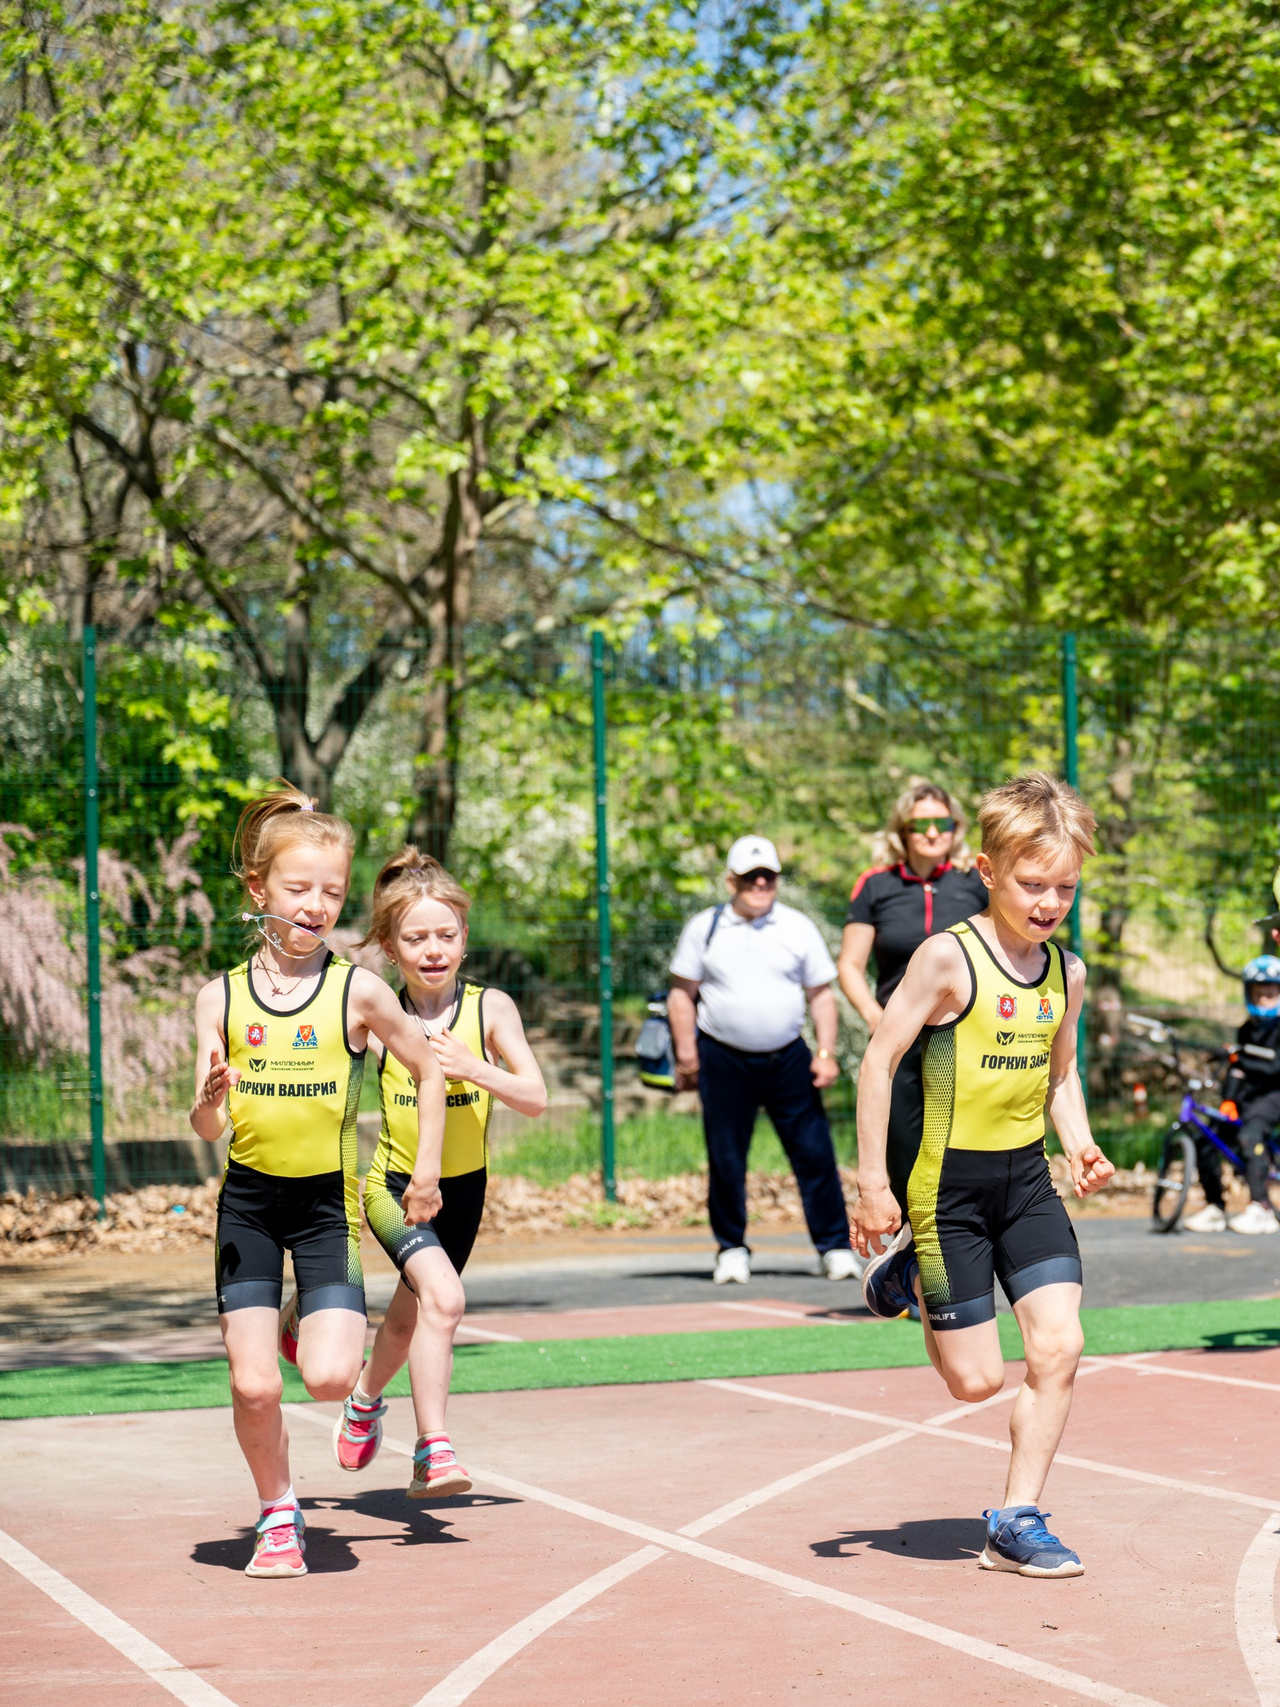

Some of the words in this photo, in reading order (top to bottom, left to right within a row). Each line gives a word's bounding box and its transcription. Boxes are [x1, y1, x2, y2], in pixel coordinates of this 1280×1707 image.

[980, 1054, 1027, 1070] ГОРКУН
[235, 1080, 275, 1097] ГОРКУН
[278, 1080, 337, 1097] ВАЛЕРИЯ
[445, 1090, 480, 1108] СЕНИЯ
